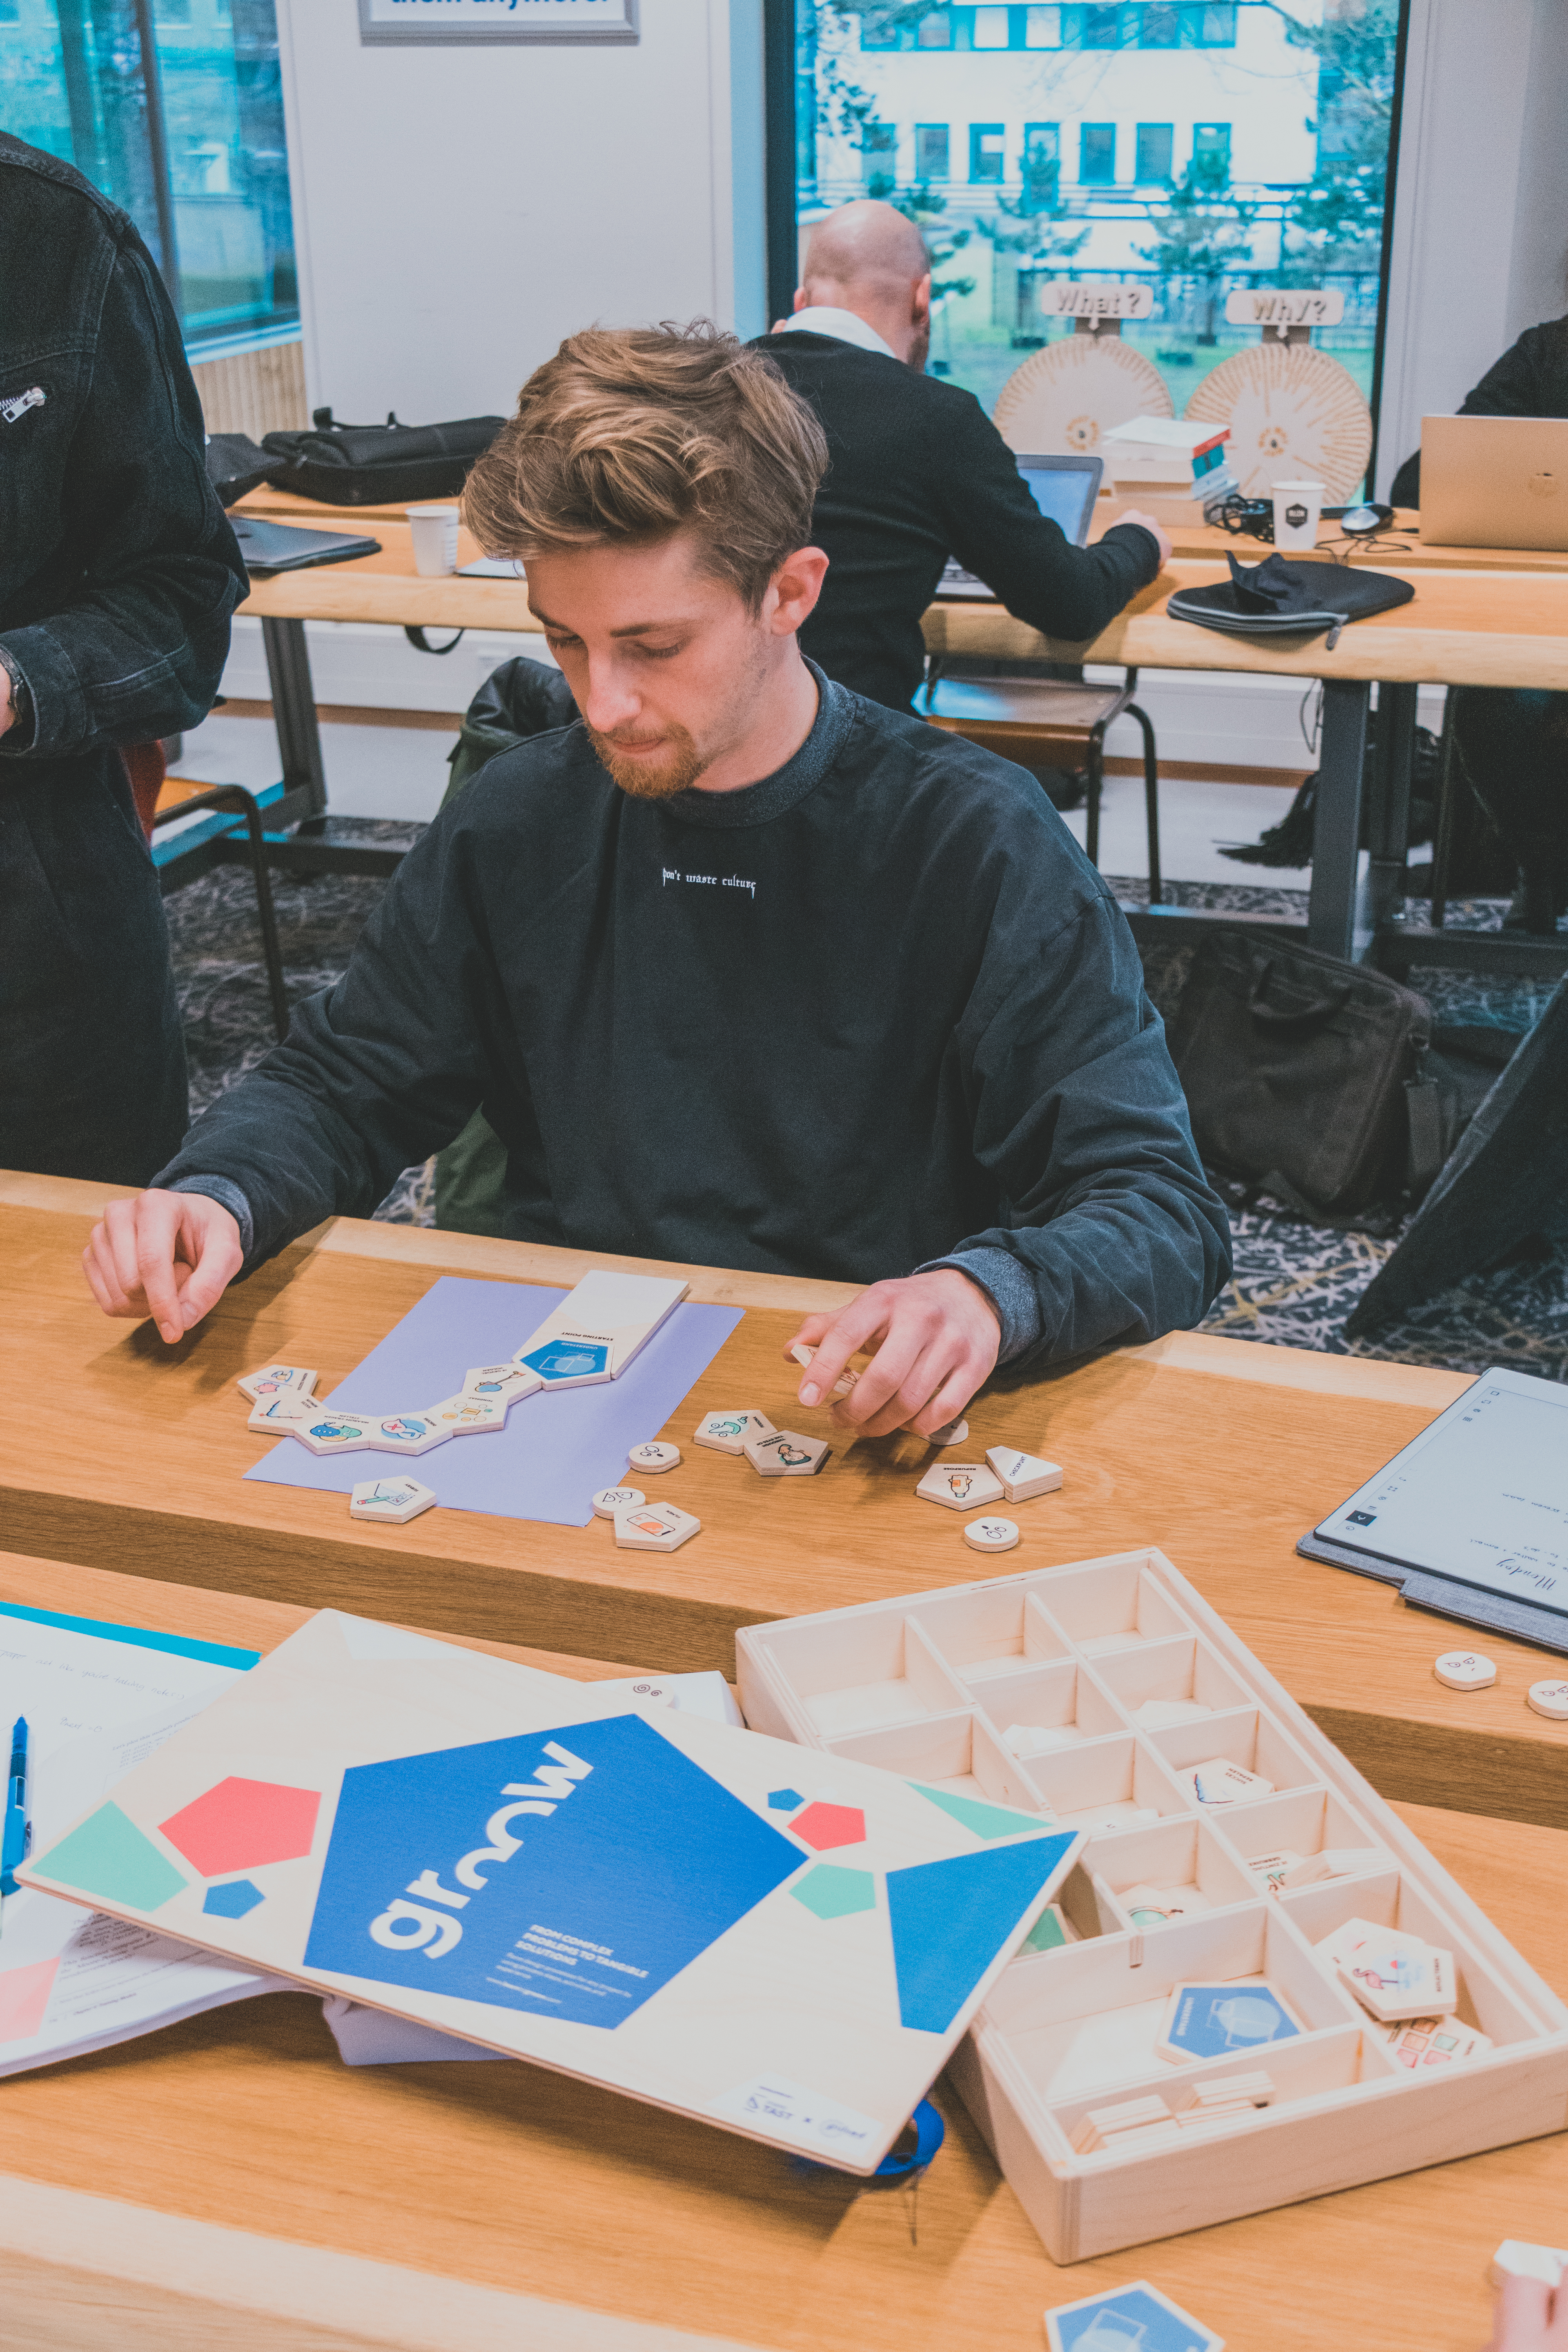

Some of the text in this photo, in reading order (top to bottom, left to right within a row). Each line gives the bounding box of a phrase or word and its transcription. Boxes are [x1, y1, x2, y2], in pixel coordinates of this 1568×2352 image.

[1057, 289, 1119, 314] What
[753, 1416, 764, 1428] PERSONA
[762, 1438, 786, 1447] THROUGH
[1009, 1456, 1027, 1477] CHECKPUNT
[405, 1483, 419, 1492] SURVEY
[666, 1510, 681, 1519] FILMEN
[1496, 1559, 1557, 1591] Monday
[1225, 1771, 1246, 1785] SUCCES
[1227, 1767, 1254, 1782] BEPALEN
[529, 1924, 615, 1956] FROM COMPLEX
[515, 1940, 578, 1966] SOLUTIONS
[522, 1932, 580, 1956] PROBLEMS
[579, 1950, 596, 1960] TO
[595, 1955, 650, 1978] TANGIBLE
